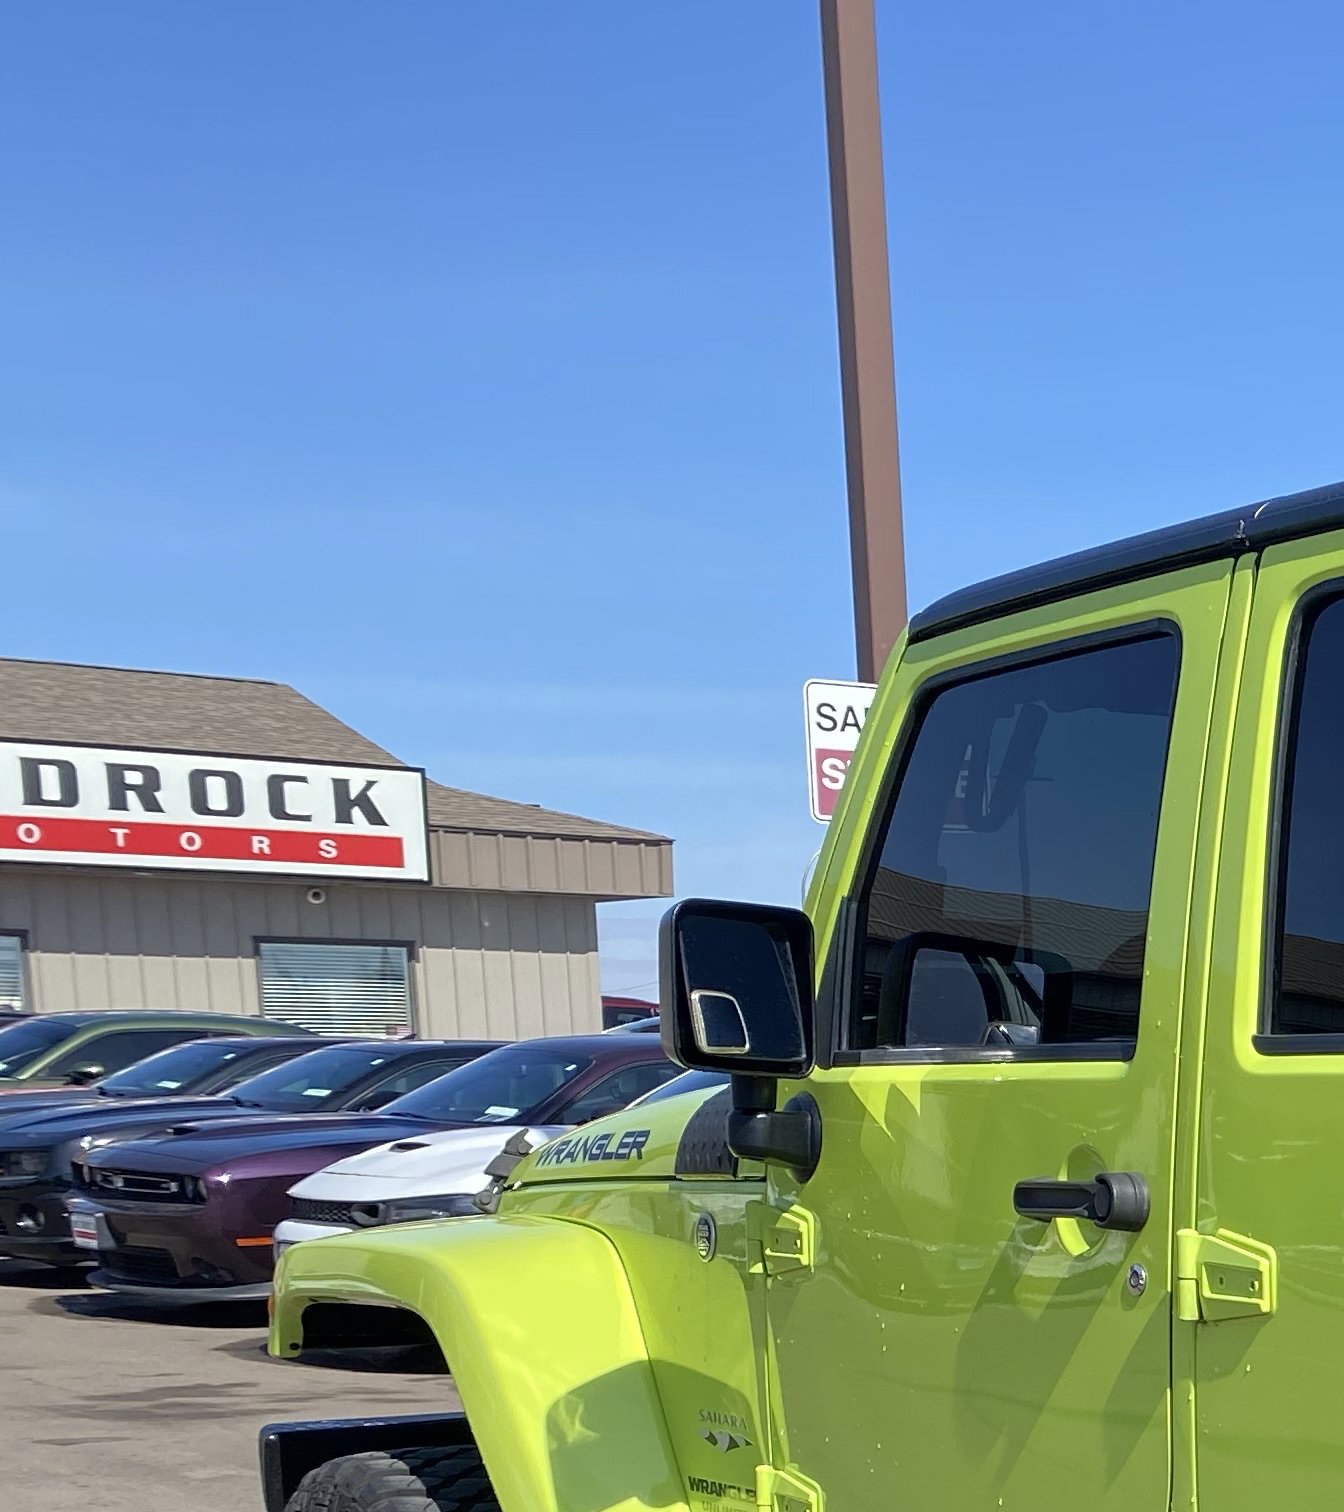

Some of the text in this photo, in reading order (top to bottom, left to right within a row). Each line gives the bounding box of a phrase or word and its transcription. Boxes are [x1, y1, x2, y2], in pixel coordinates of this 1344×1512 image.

[815, 702, 869, 734] SA
[821, 757, 852, 790] S
[535, 1129, 651, 1168] WRANGLER
[699, 1409, 750, 1432] SAHARA
[688, 1475, 757, 1498] WRANGLE
